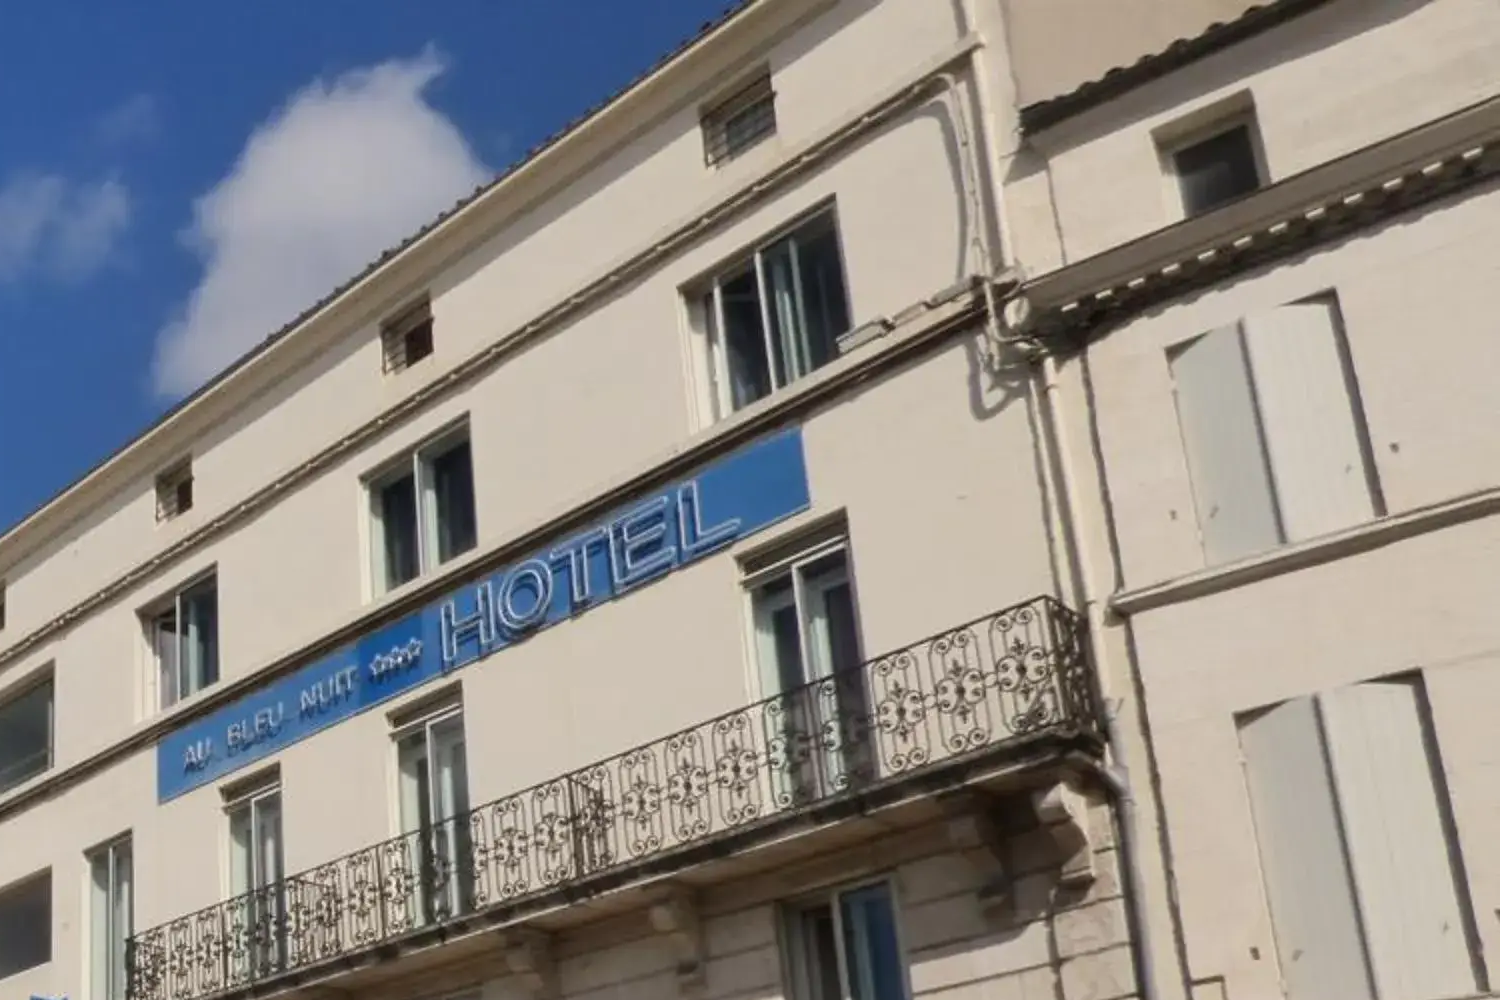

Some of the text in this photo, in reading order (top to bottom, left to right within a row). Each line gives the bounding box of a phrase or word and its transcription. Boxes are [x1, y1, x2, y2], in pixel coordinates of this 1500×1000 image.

[441, 480, 741, 662] HOTEL
[183, 665, 359, 769] AU BLEU NUIT
